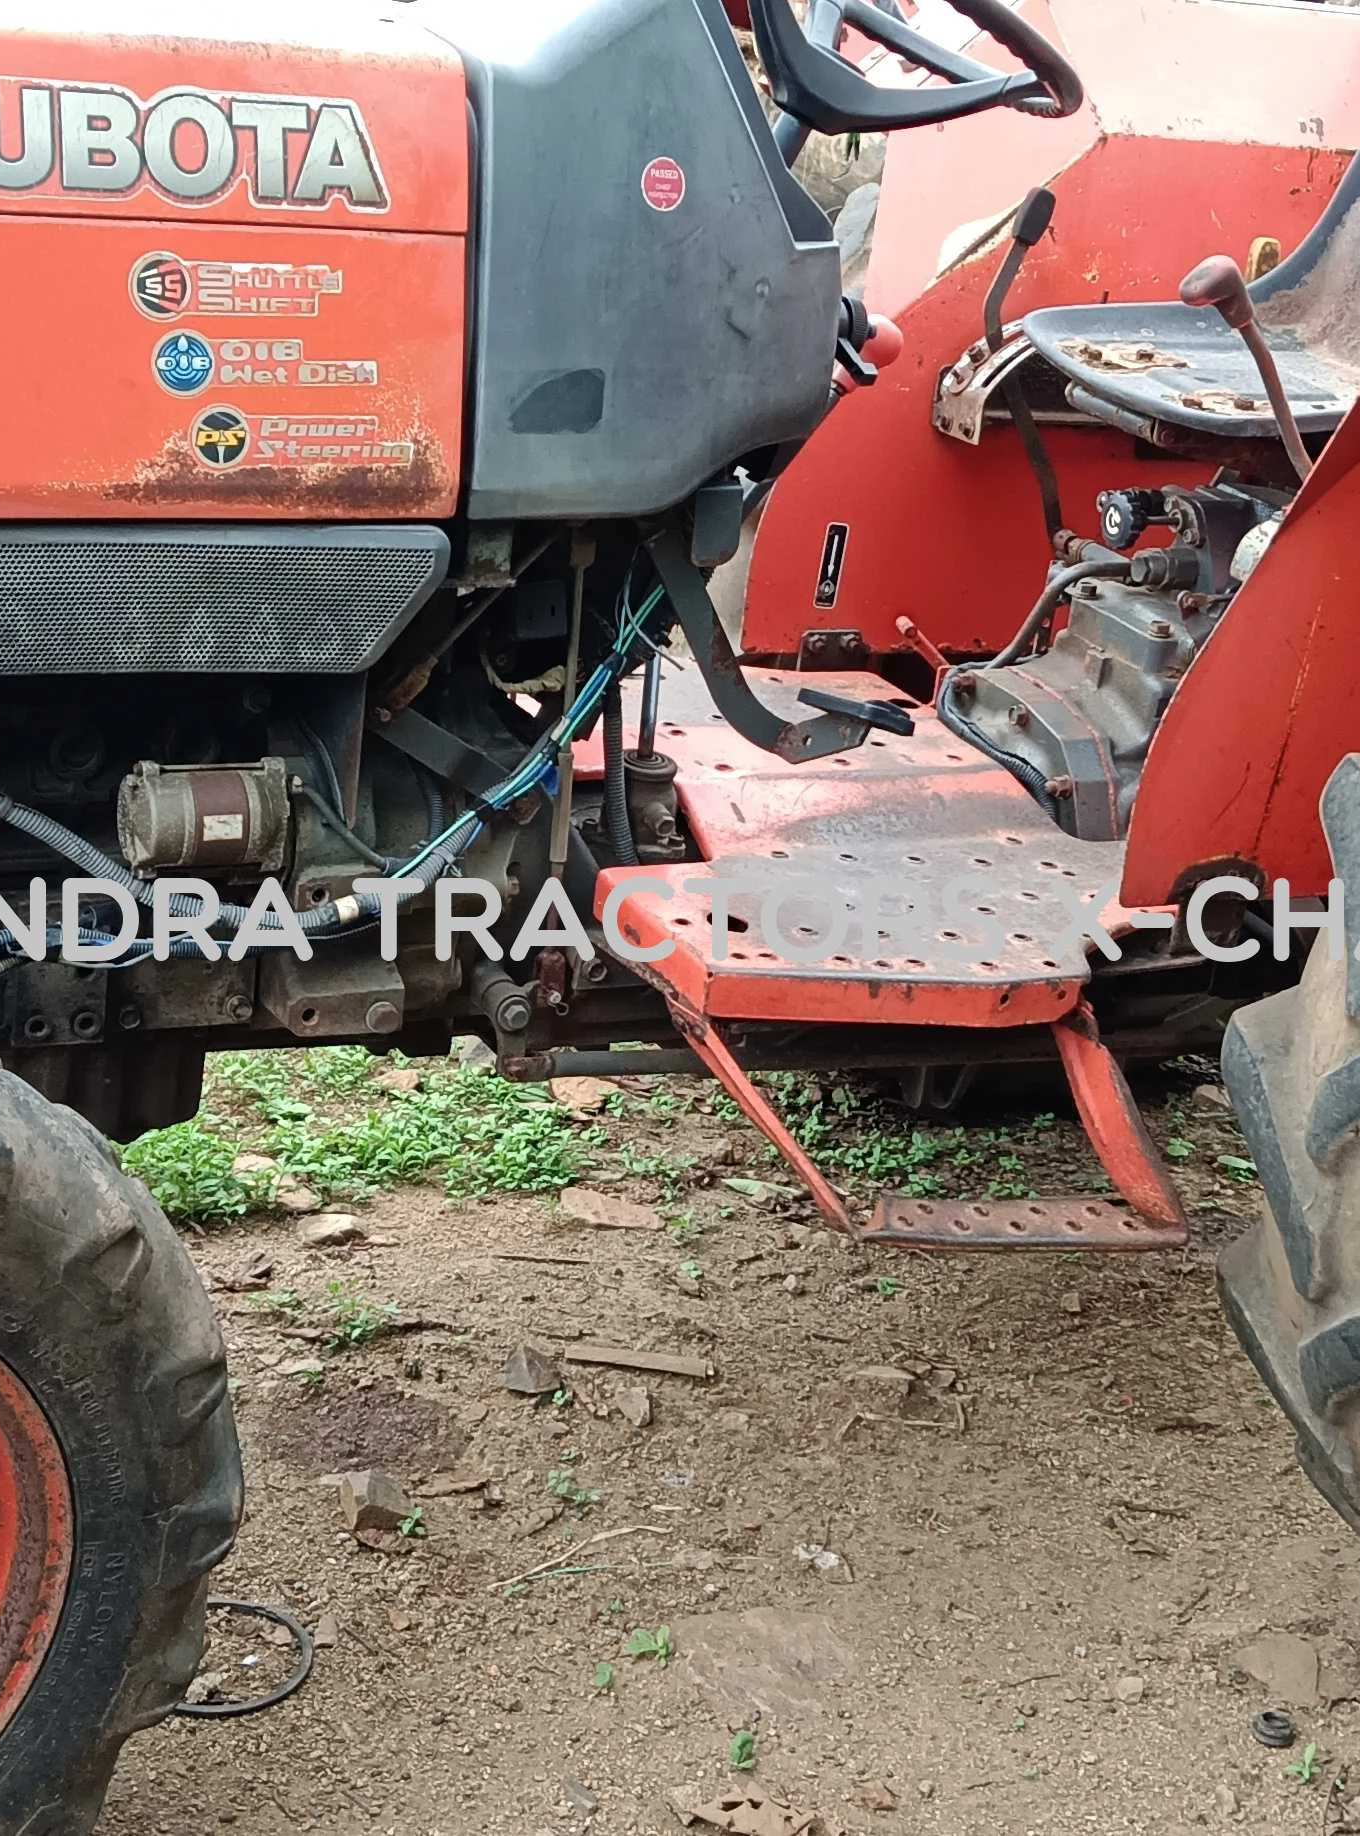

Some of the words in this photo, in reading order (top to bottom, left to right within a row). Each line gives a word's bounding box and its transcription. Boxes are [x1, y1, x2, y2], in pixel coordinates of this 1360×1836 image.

[197, 289, 315, 313] SHIFT
[220, 340, 301, 362] OIB
[219, 364, 289, 384] Wet
[298, 363, 376, 384] Disk
[259, 418, 376, 438] Power
[252, 440, 412, 464] Steering
[78, 1543, 98, 1579] FOR
[87, 1551, 125, 1649] NYLON
